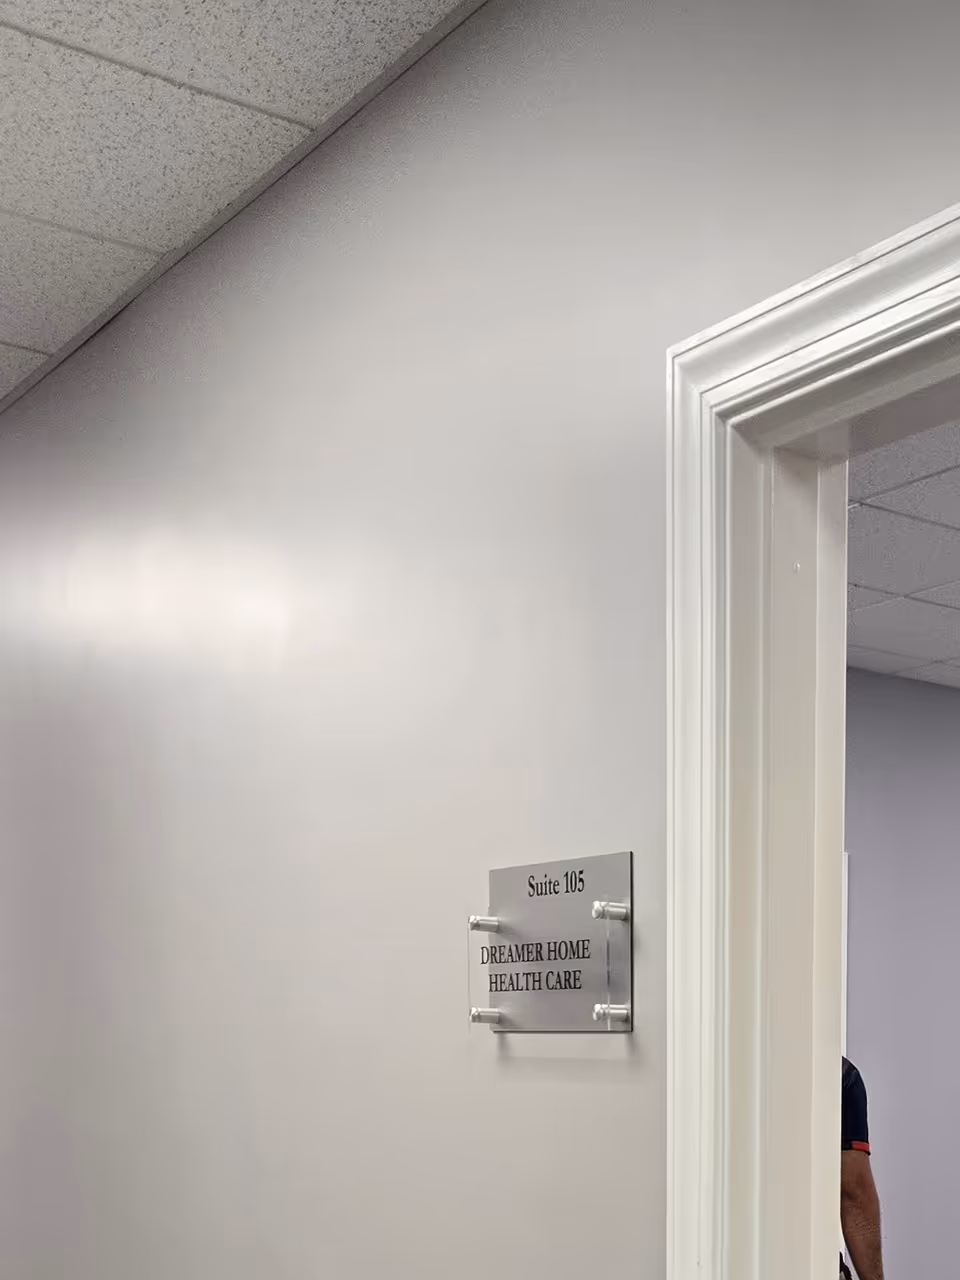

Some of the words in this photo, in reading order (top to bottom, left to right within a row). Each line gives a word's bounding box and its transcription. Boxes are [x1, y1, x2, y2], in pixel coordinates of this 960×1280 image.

[528, 874, 560, 897] Suite
[564, 870, 585, 893] 105
[480, 943, 543, 964] DREAMER
[547, 939, 591, 960] HOME
[488, 971, 542, 992] HEALTH
[546, 970, 582, 990] CARE
